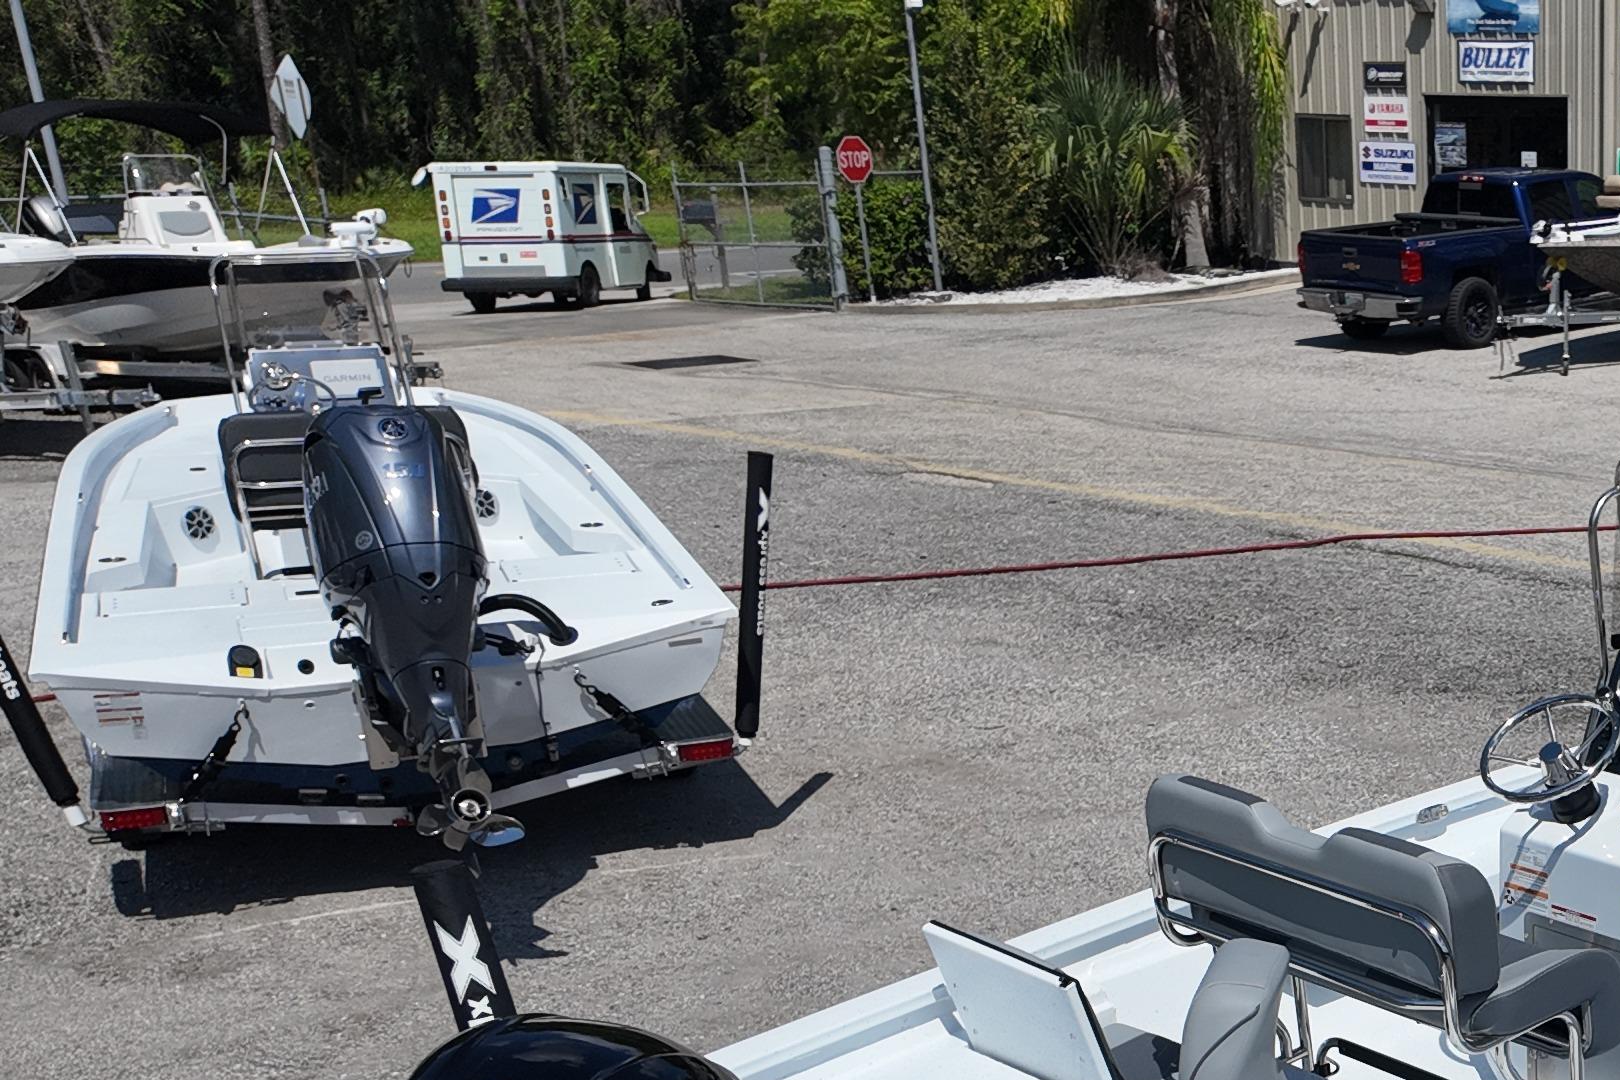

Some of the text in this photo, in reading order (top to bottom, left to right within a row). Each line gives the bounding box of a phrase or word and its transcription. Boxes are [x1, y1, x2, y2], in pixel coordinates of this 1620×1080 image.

[1462, 47, 1530, 68] BULLET
[1377, 103, 1404, 113] YAMAHA
[1373, 149, 1414, 159] SUZUKI
[840, 151, 868, 168] STOP
[323, 374, 371, 382] GARMIN
